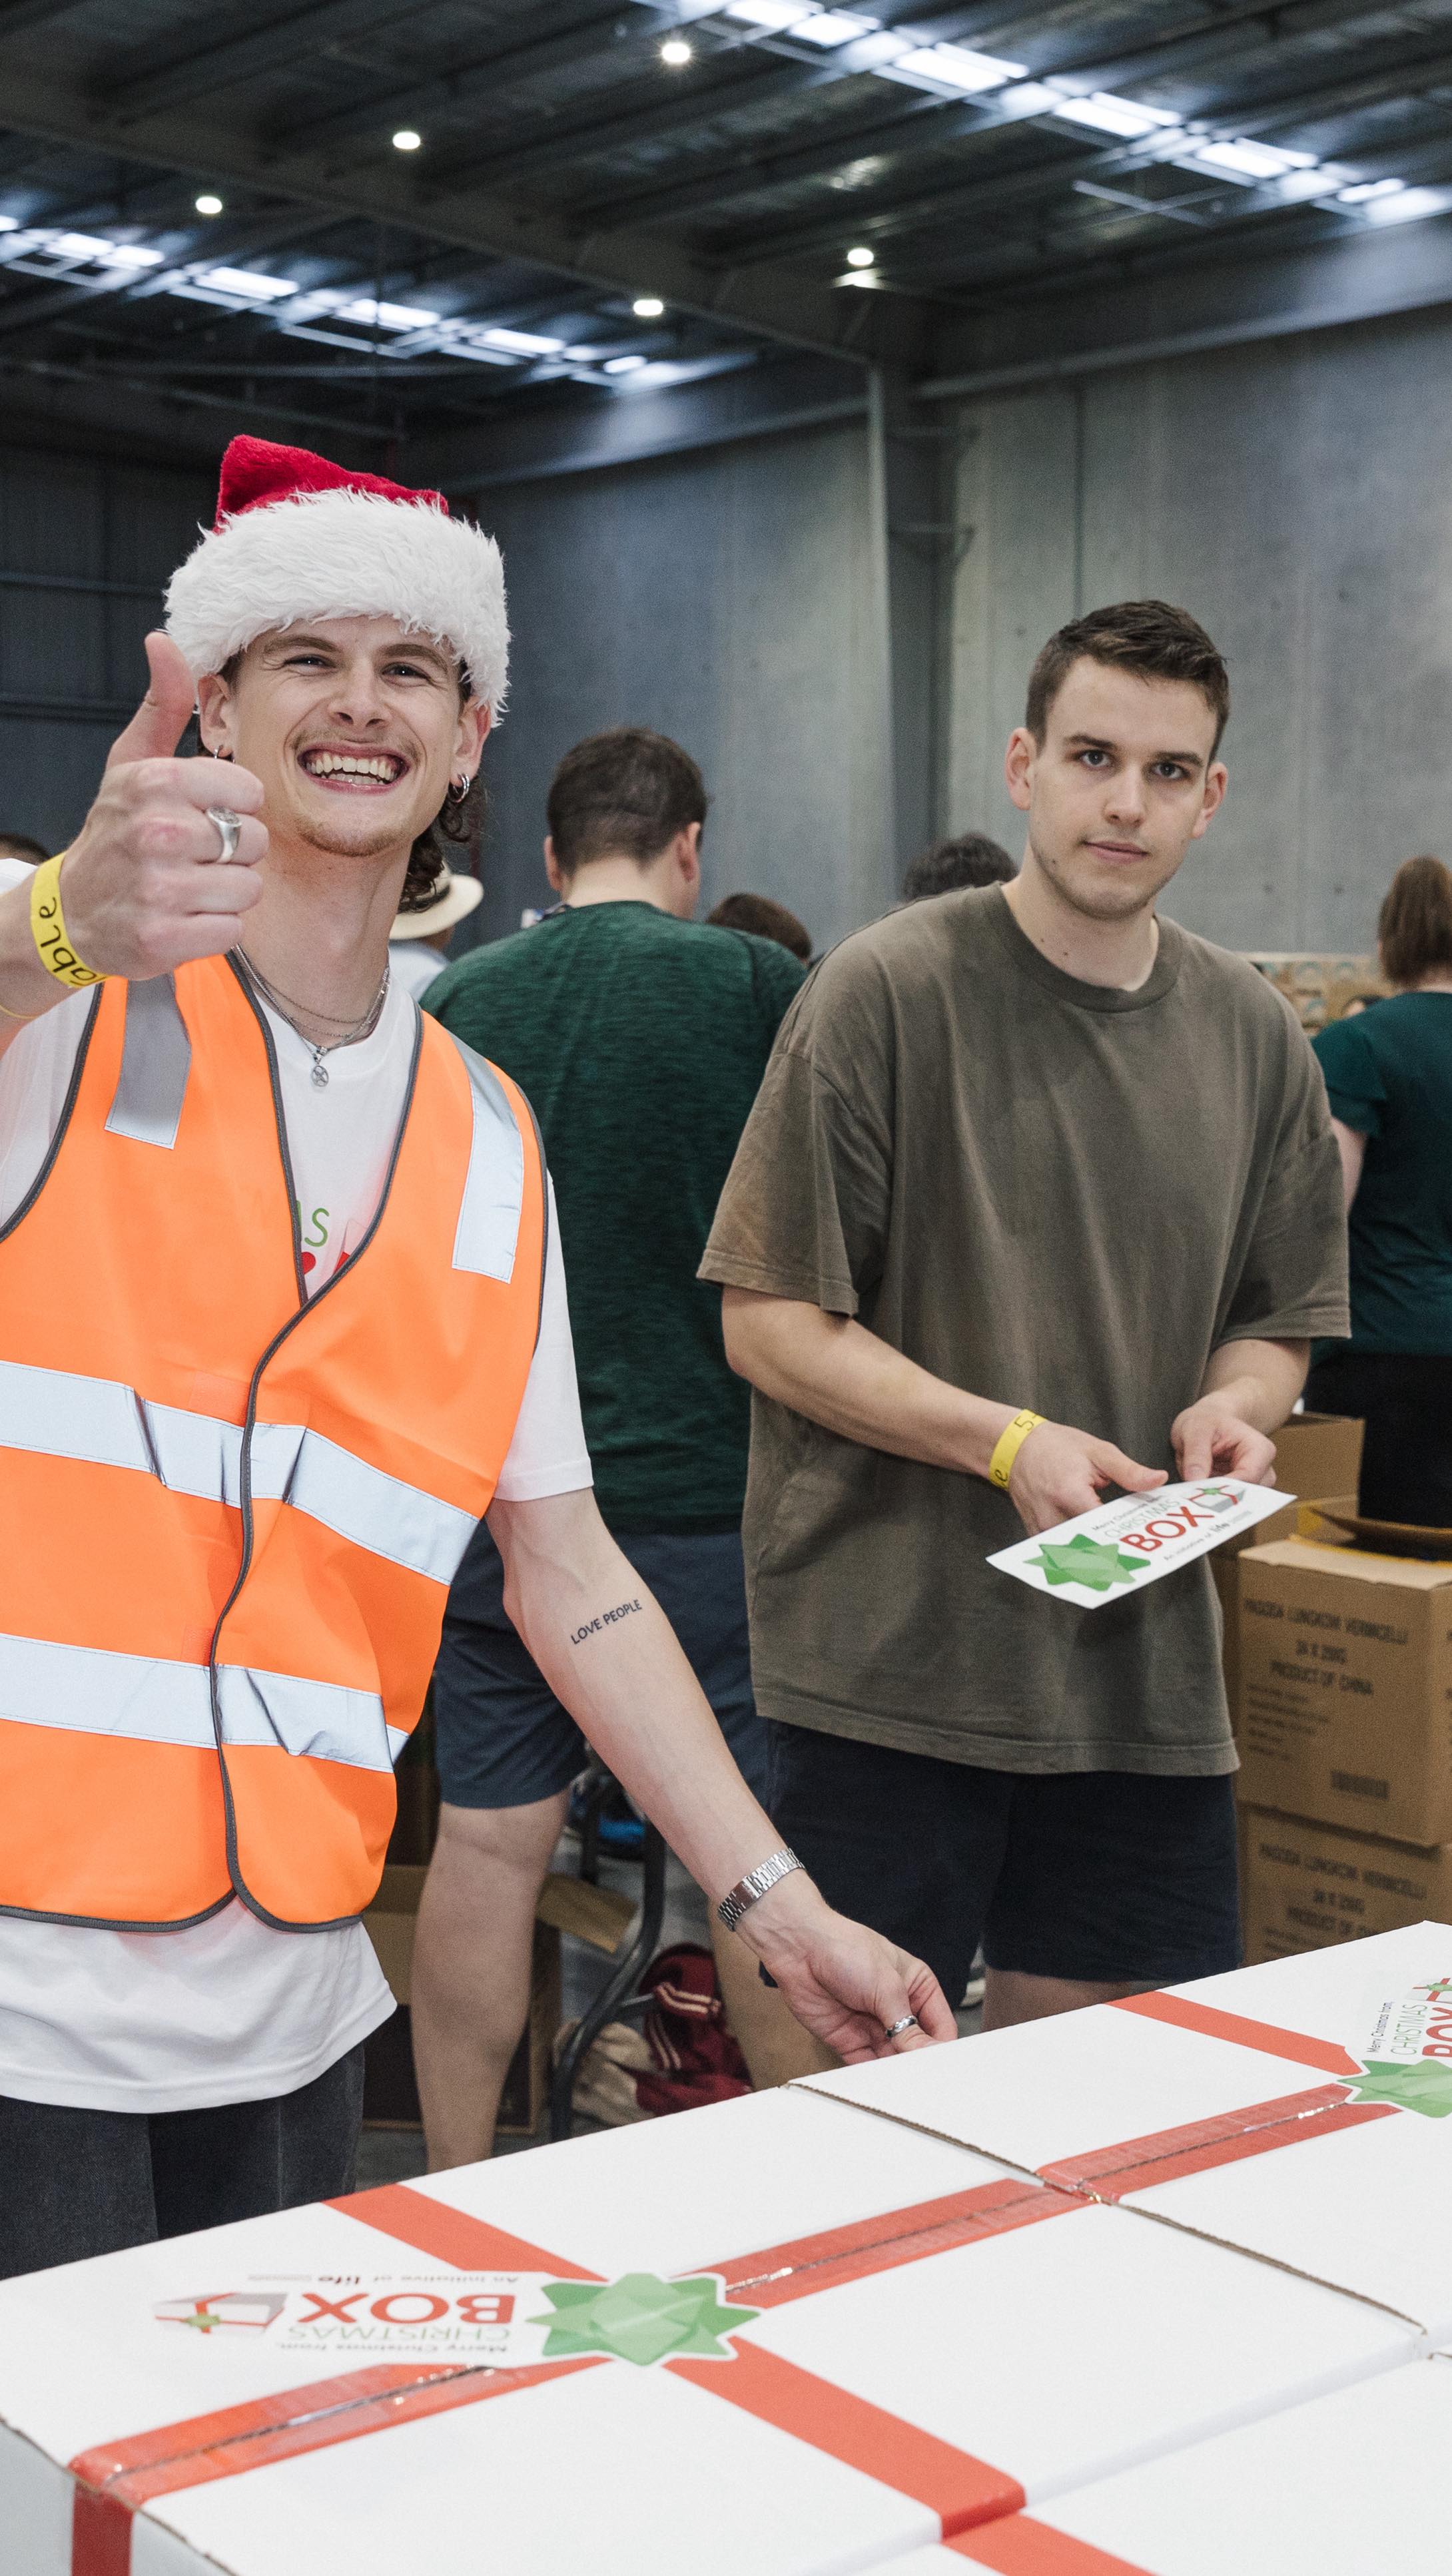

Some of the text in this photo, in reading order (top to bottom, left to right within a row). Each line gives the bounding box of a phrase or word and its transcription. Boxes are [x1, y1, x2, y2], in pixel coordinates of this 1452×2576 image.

[1104, 1498, 1180, 1539] CHRISTMAS
[1119, 1506, 1215, 1552] BOX
[571, 1599, 642, 1644] LOVE PEOPLE
[1371, 2013, 1390, 2037] Christmas
[1391, 2005, 1427, 2055] CHRISTMAS
[1366, 2037, 1386, 2053] Merry
[318, 2275, 361, 2286] life
[297, 2292, 516, 2324] BOX
[288, 2326, 510, 2342] CHRISTMAS
